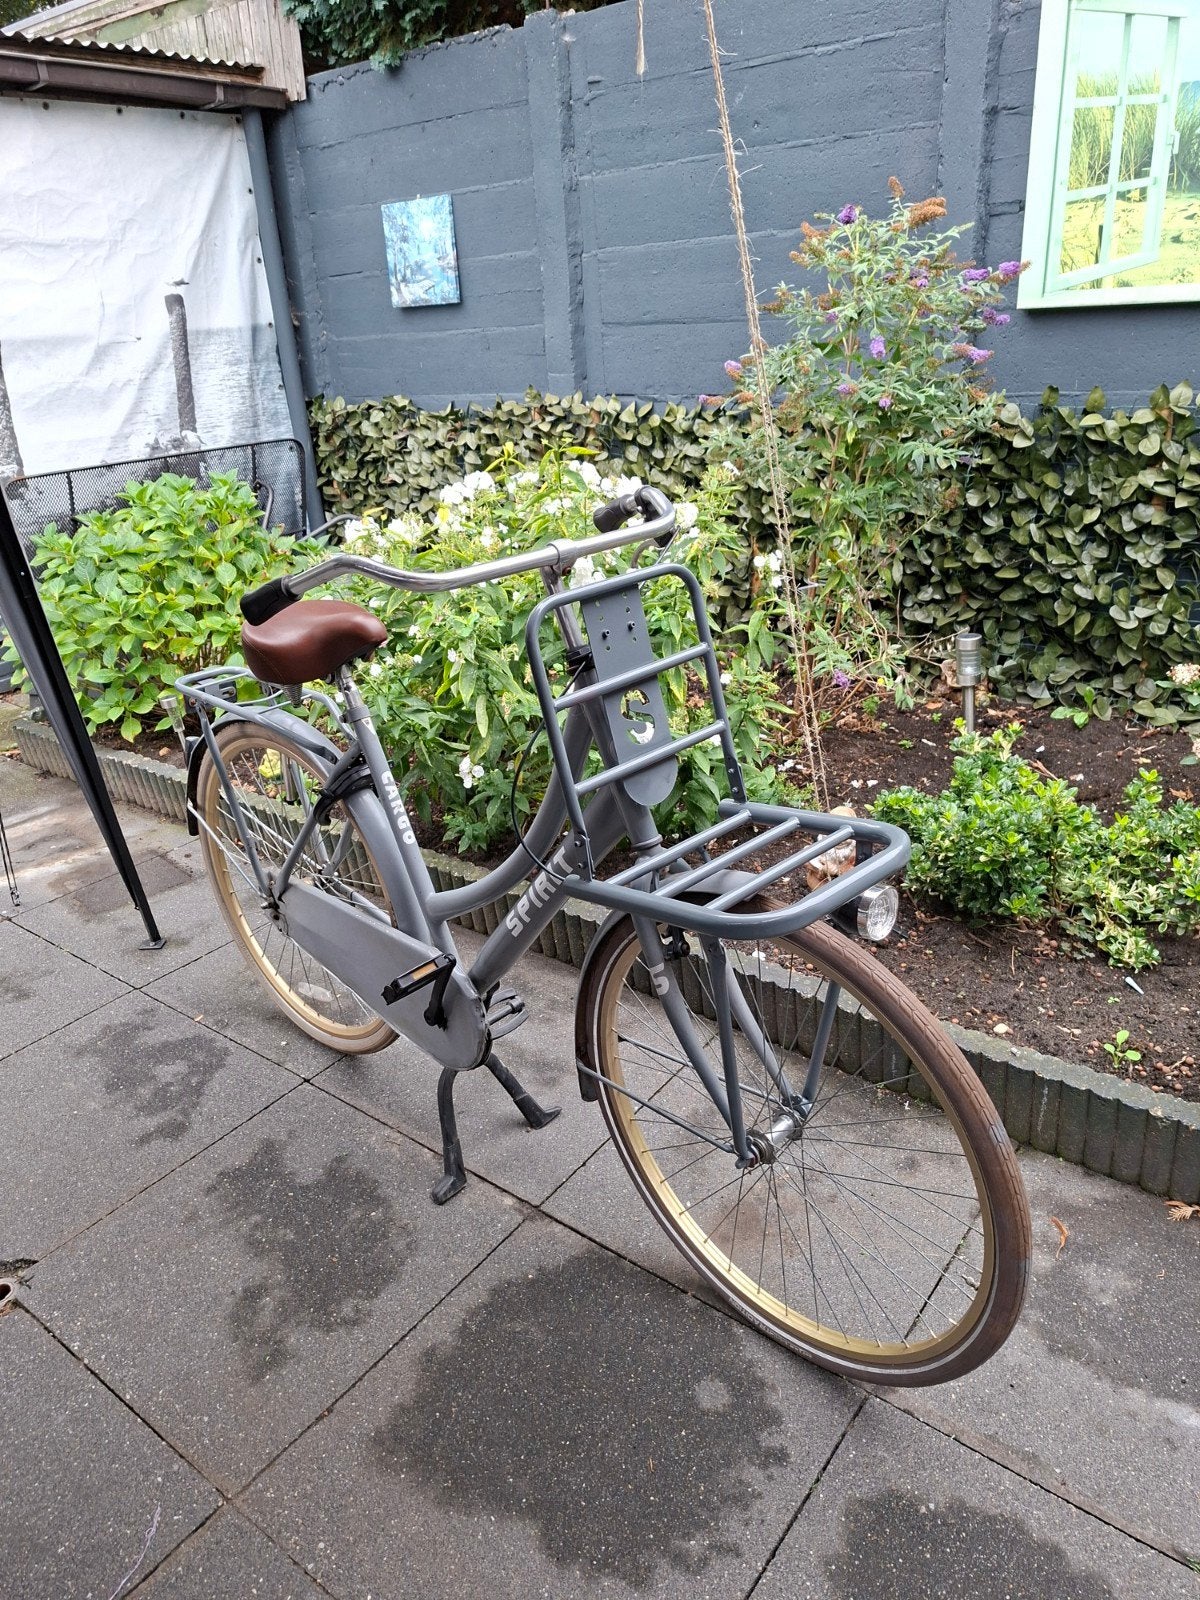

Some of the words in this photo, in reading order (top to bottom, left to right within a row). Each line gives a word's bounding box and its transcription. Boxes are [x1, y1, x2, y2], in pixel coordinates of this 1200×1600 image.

[620, 688, 655, 745] S
[381, 770, 416, 845] CARGO
[505, 845, 574, 938] SPIRIT
